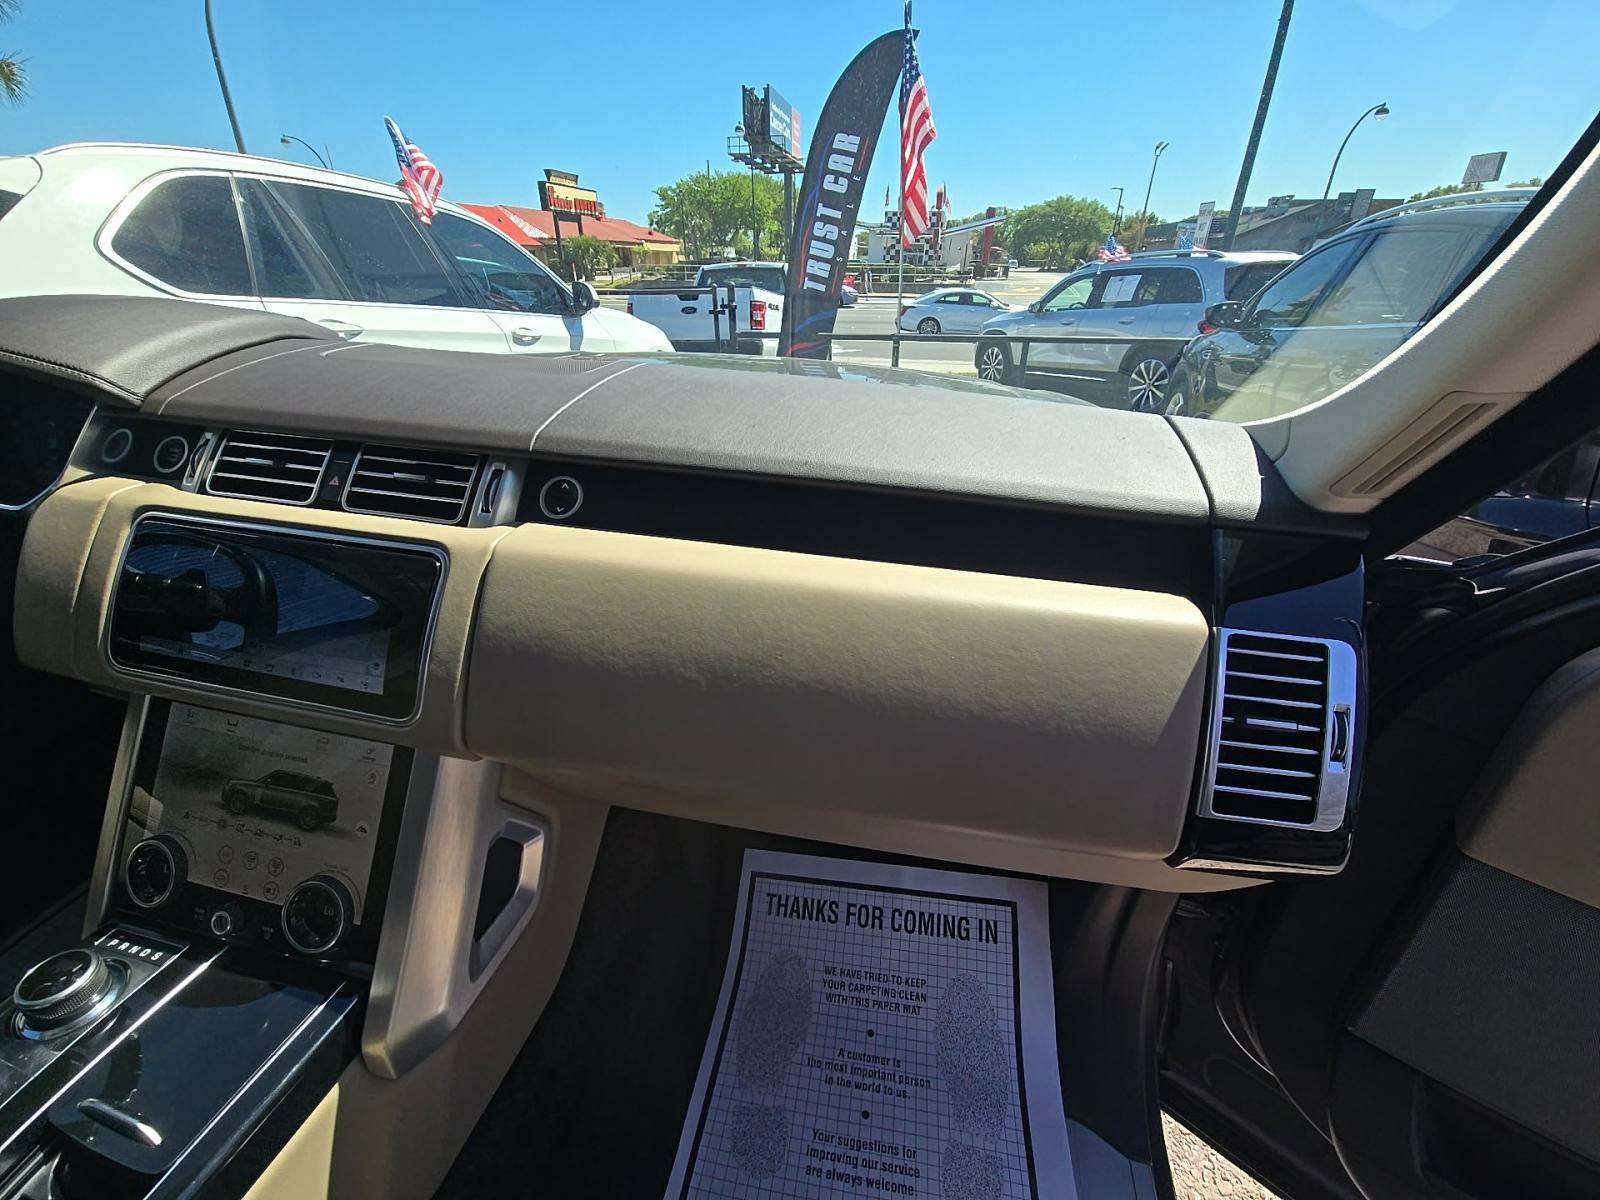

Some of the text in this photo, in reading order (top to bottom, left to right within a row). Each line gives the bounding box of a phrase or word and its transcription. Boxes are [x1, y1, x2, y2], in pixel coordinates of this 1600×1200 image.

[804, 133, 860, 292] TRUST CAR
[836, 175, 861, 262] SALE
[766, 893, 998, 945] THANKS FOR COMING IN
[822, 978, 927, 1002] YOUR CARPETING CLEAN
[824, 966, 927, 988] WE HAVE TRIED TO KEEP
[826, 992, 922, 1015] WITH THIS PAPER MAT
[837, 1048, 845, 1058] A
[847, 1050, 890, 1066] customer
[808, 1057, 931, 1088] the most important person
[837, 1076, 851, 1088] the
[854, 1081, 880, 1093] world
[884, 1085, 893, 1096] to
[896, 1090, 911, 1099] us.
[812, 1129, 917, 1159] Your suggestions for
[806, 1145, 920, 1178] improving our service
[805, 1165, 918, 1197] are always welcome.
